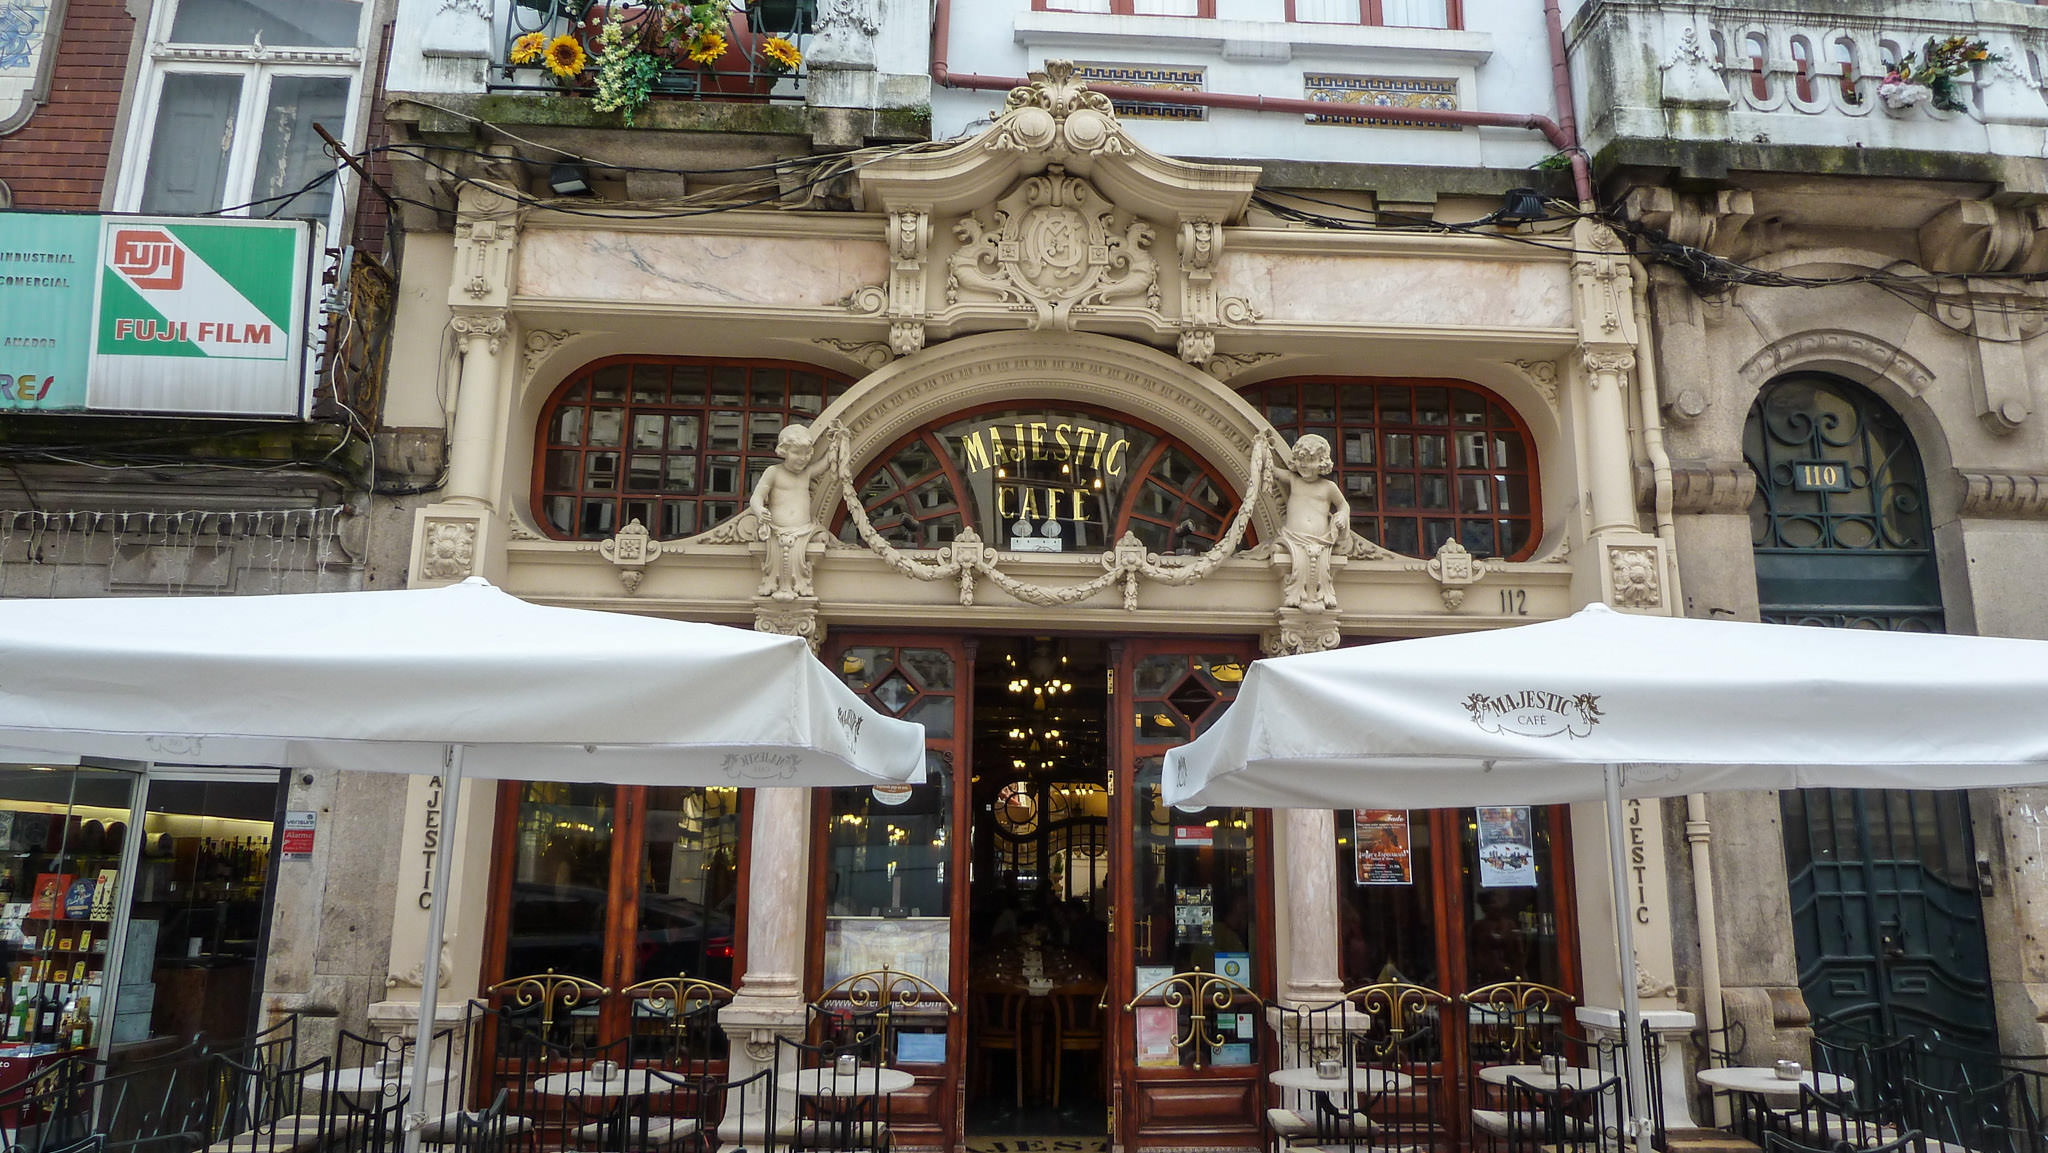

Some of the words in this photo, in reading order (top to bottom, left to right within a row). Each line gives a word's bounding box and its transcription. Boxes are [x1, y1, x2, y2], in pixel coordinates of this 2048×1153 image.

[0, 252, 75, 263] INDUSTRIAL
[115, 319, 189, 342] FUJI
[198, 321, 272, 345] FILM
[961, 422, 1131, 478] MAJESTIC
[1804, 465, 1837, 486] 110
[998, 479, 1091, 521] CAFÉ
[1500, 589, 1528, 616] 112
[1488, 690, 1574, 717] MAJESTIC
[1517, 714, 1547, 726] CAFÉ
